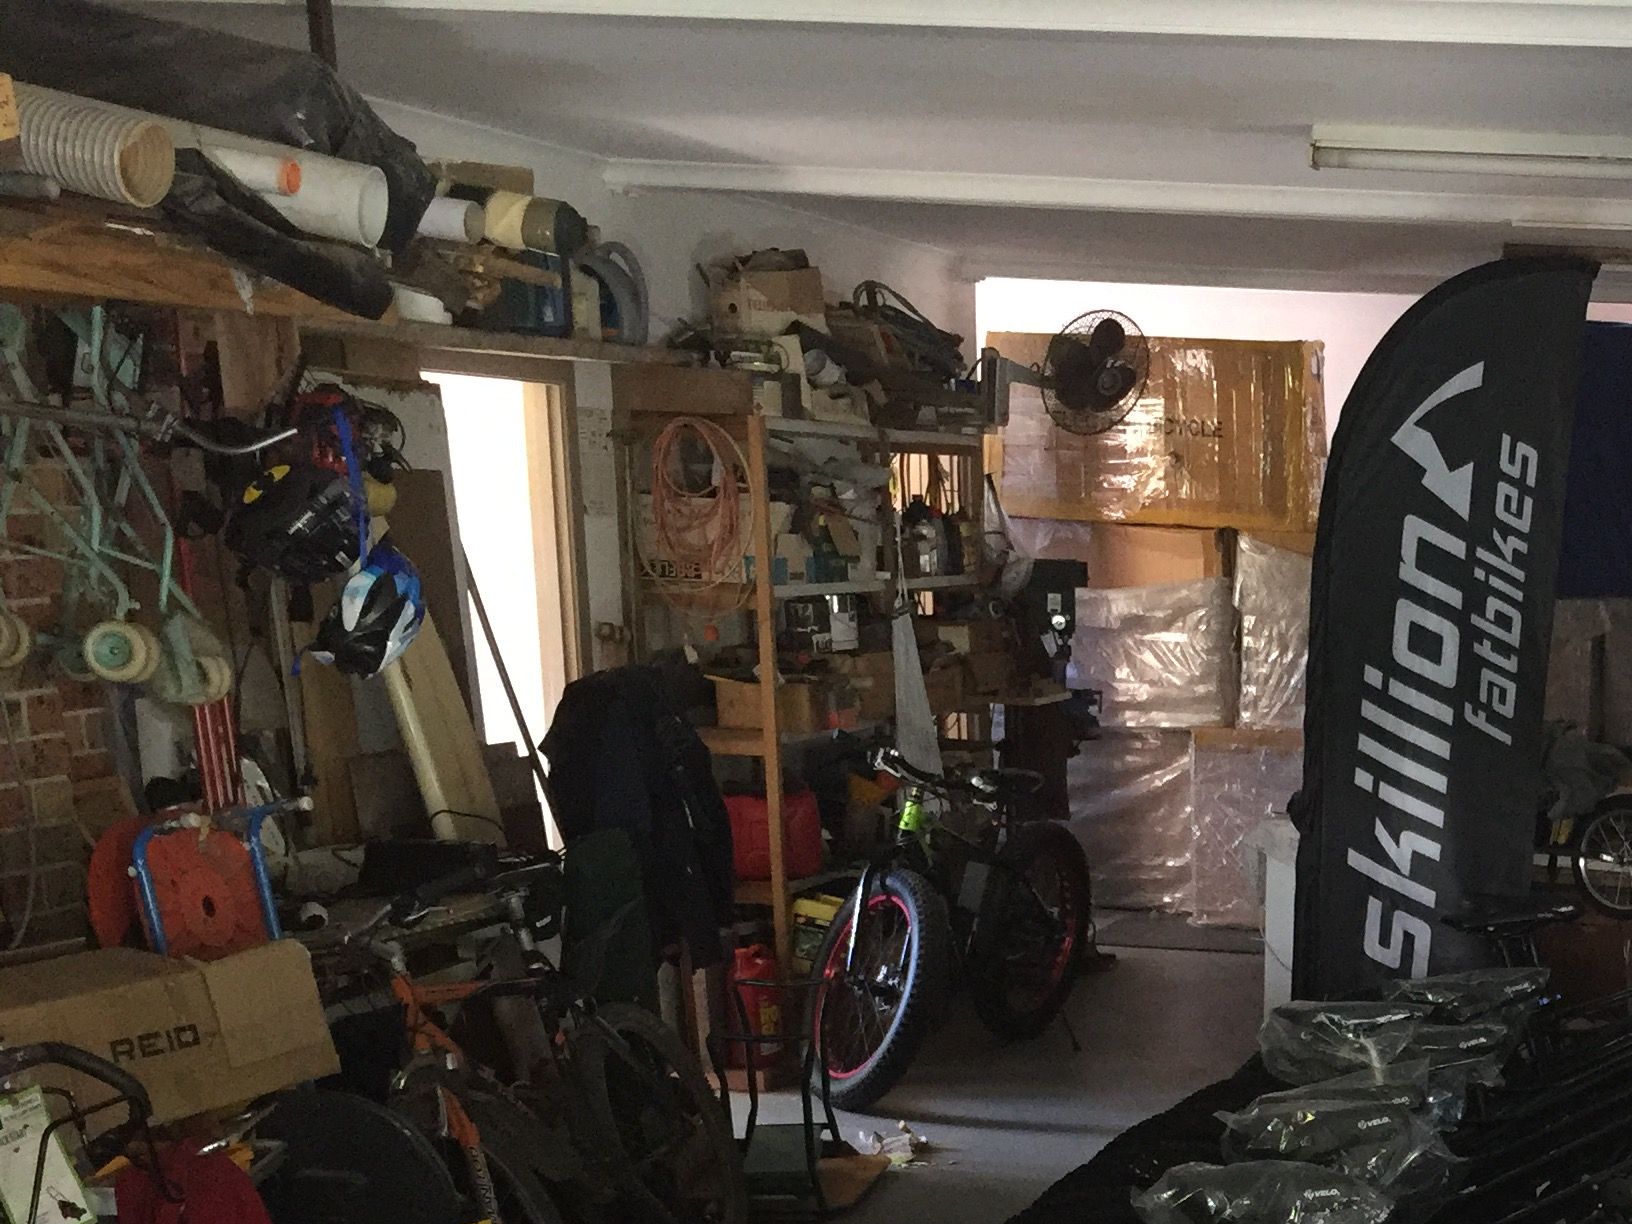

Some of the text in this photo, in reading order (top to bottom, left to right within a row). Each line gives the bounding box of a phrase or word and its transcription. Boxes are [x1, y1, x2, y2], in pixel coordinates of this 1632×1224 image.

[1463, 433, 1539, 745] fatbikes
[1346, 513, 1467, 980] skillion
[110, 1024, 201, 1062] REID
